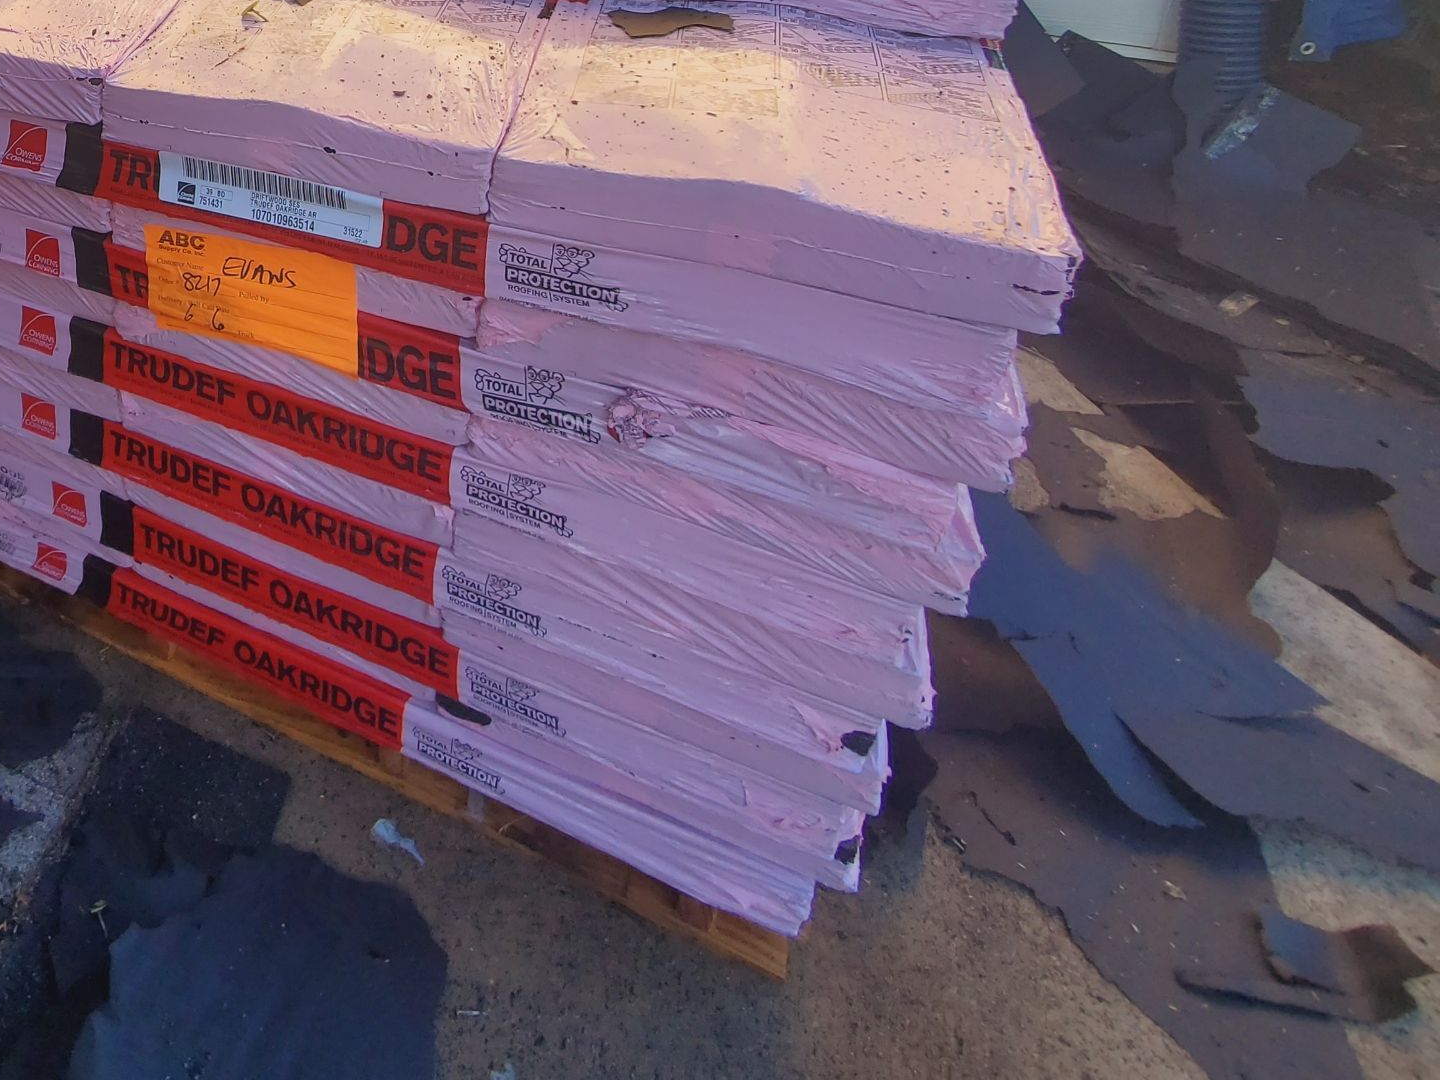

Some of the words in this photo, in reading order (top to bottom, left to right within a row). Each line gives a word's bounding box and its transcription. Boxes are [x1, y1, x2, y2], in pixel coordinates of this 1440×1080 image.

[15, 147, 42, 162] OWENS
[199, 196, 223, 209] 751431
[251, 191, 287, 205] DRIFTWOOD
[250, 199, 274, 210] TRUDEF
[275, 205, 307, 217] OAKRIDGE
[307, 211, 318, 219] AR
[251, 208, 315, 232] 107010963514
[157, 230, 206, 250] ABC
[343, 226, 363, 239] 31522
[158, 245, 181, 255] Supply
[28, 260, 59, 275] CORNING
[33, 254, 59, 269] OWENS
[509, 252, 547, 270] TOTAL
[222, 256, 297, 289] EVANS
[506, 268, 619, 302] PROTECTION
[507, 284, 548, 300] ROOFING
[552, 294, 591, 308] SYSTEM
[22, 334, 53, 350] CORNING
[28, 328, 55, 344] OWENS
[485, 378, 524, 397] TOTAL
[109, 340, 237, 404] TRUDEF
[246, 390, 443, 483] OAKRIDGE
[484, 396, 587, 434] PROTECTION
[470, 474, 505, 492] TOTAL
[110, 429, 232, 497] TRUDEF
[240, 482, 427, 581] OAKRIDGE
[468, 486, 564, 529] PROTECTION
[468, 498, 505, 516] ROOFING
[508, 512, 541, 528] SYSTEM
[451, 574, 482, 591] TOTAL
[139, 523, 261, 592] TRUDEF
[269, 579, 450, 680] OAKRIDGE
[448, 583, 539, 628] PROTECTION
[449, 596, 483, 615] ROOFING
[485, 611, 517, 628] SYSTEM
[116, 581, 227, 647] TRUDEF
[233, 640, 398, 738] OAKRIDGE
[473, 673, 504, 691] TOTAL
[472, 683, 558, 730] PROTECTION
[421, 733, 448, 750] TOTAL
[418, 742, 498, 788] PROTECTION
